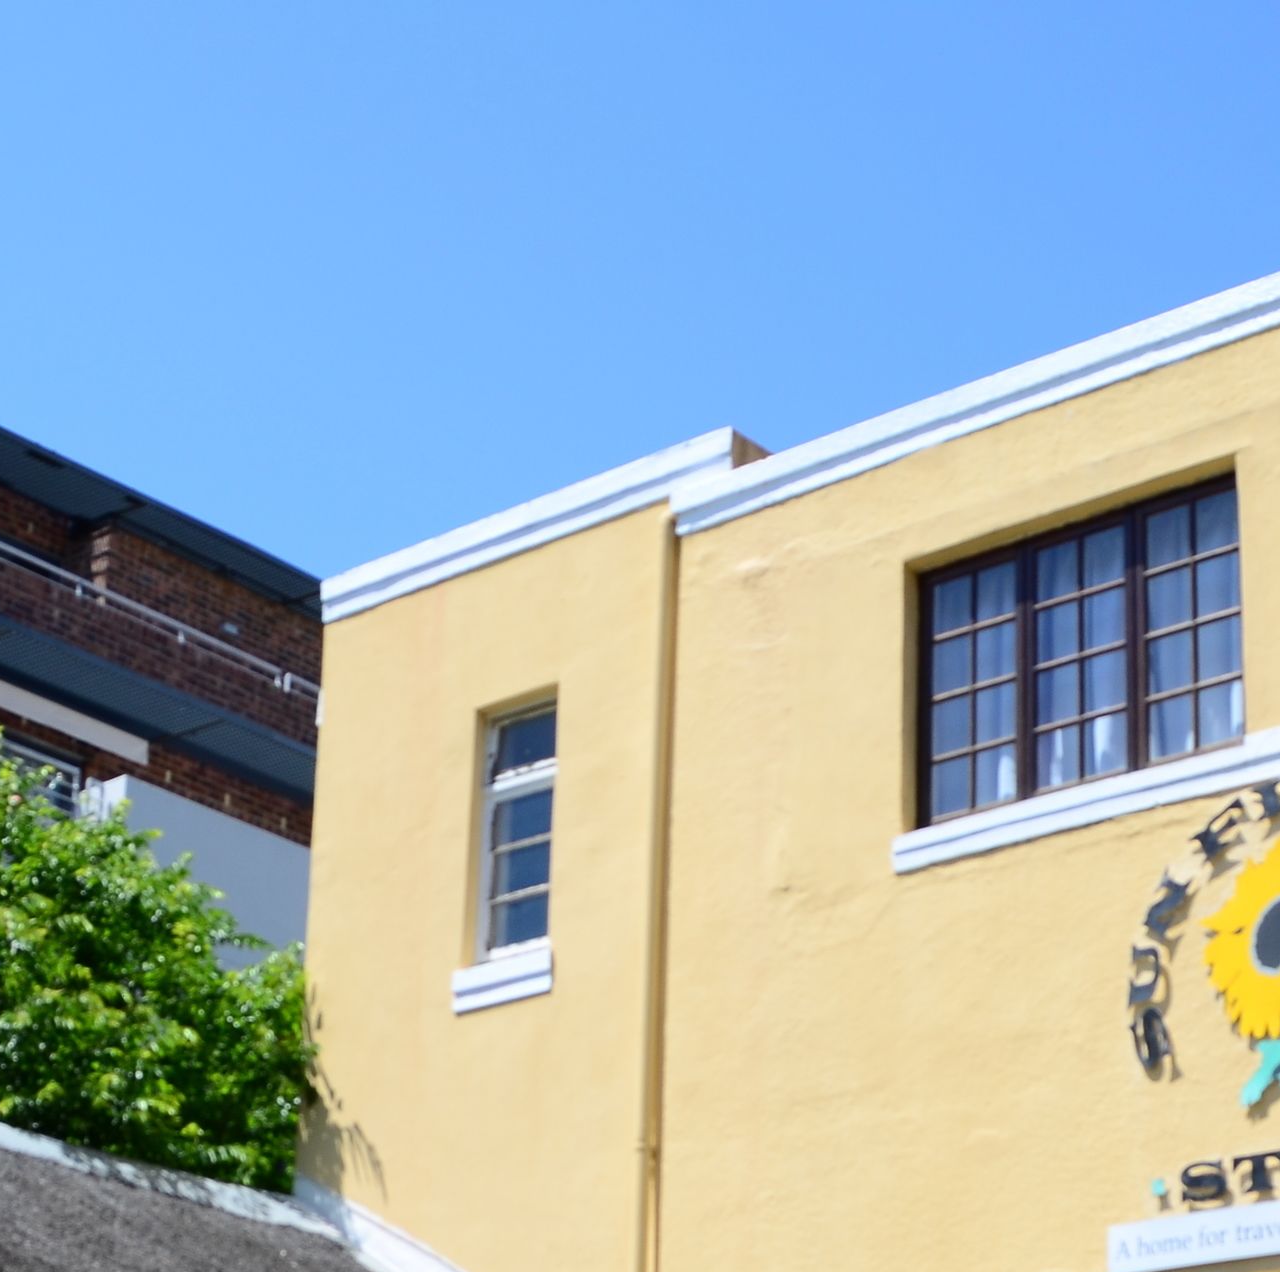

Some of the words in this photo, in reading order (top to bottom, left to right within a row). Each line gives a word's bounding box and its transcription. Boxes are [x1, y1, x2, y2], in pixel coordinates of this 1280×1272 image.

[1116, 1240, 1131, 1260] A
[1136, 1236, 1193, 1258] home
[1198, 1225, 1227, 1248] for
